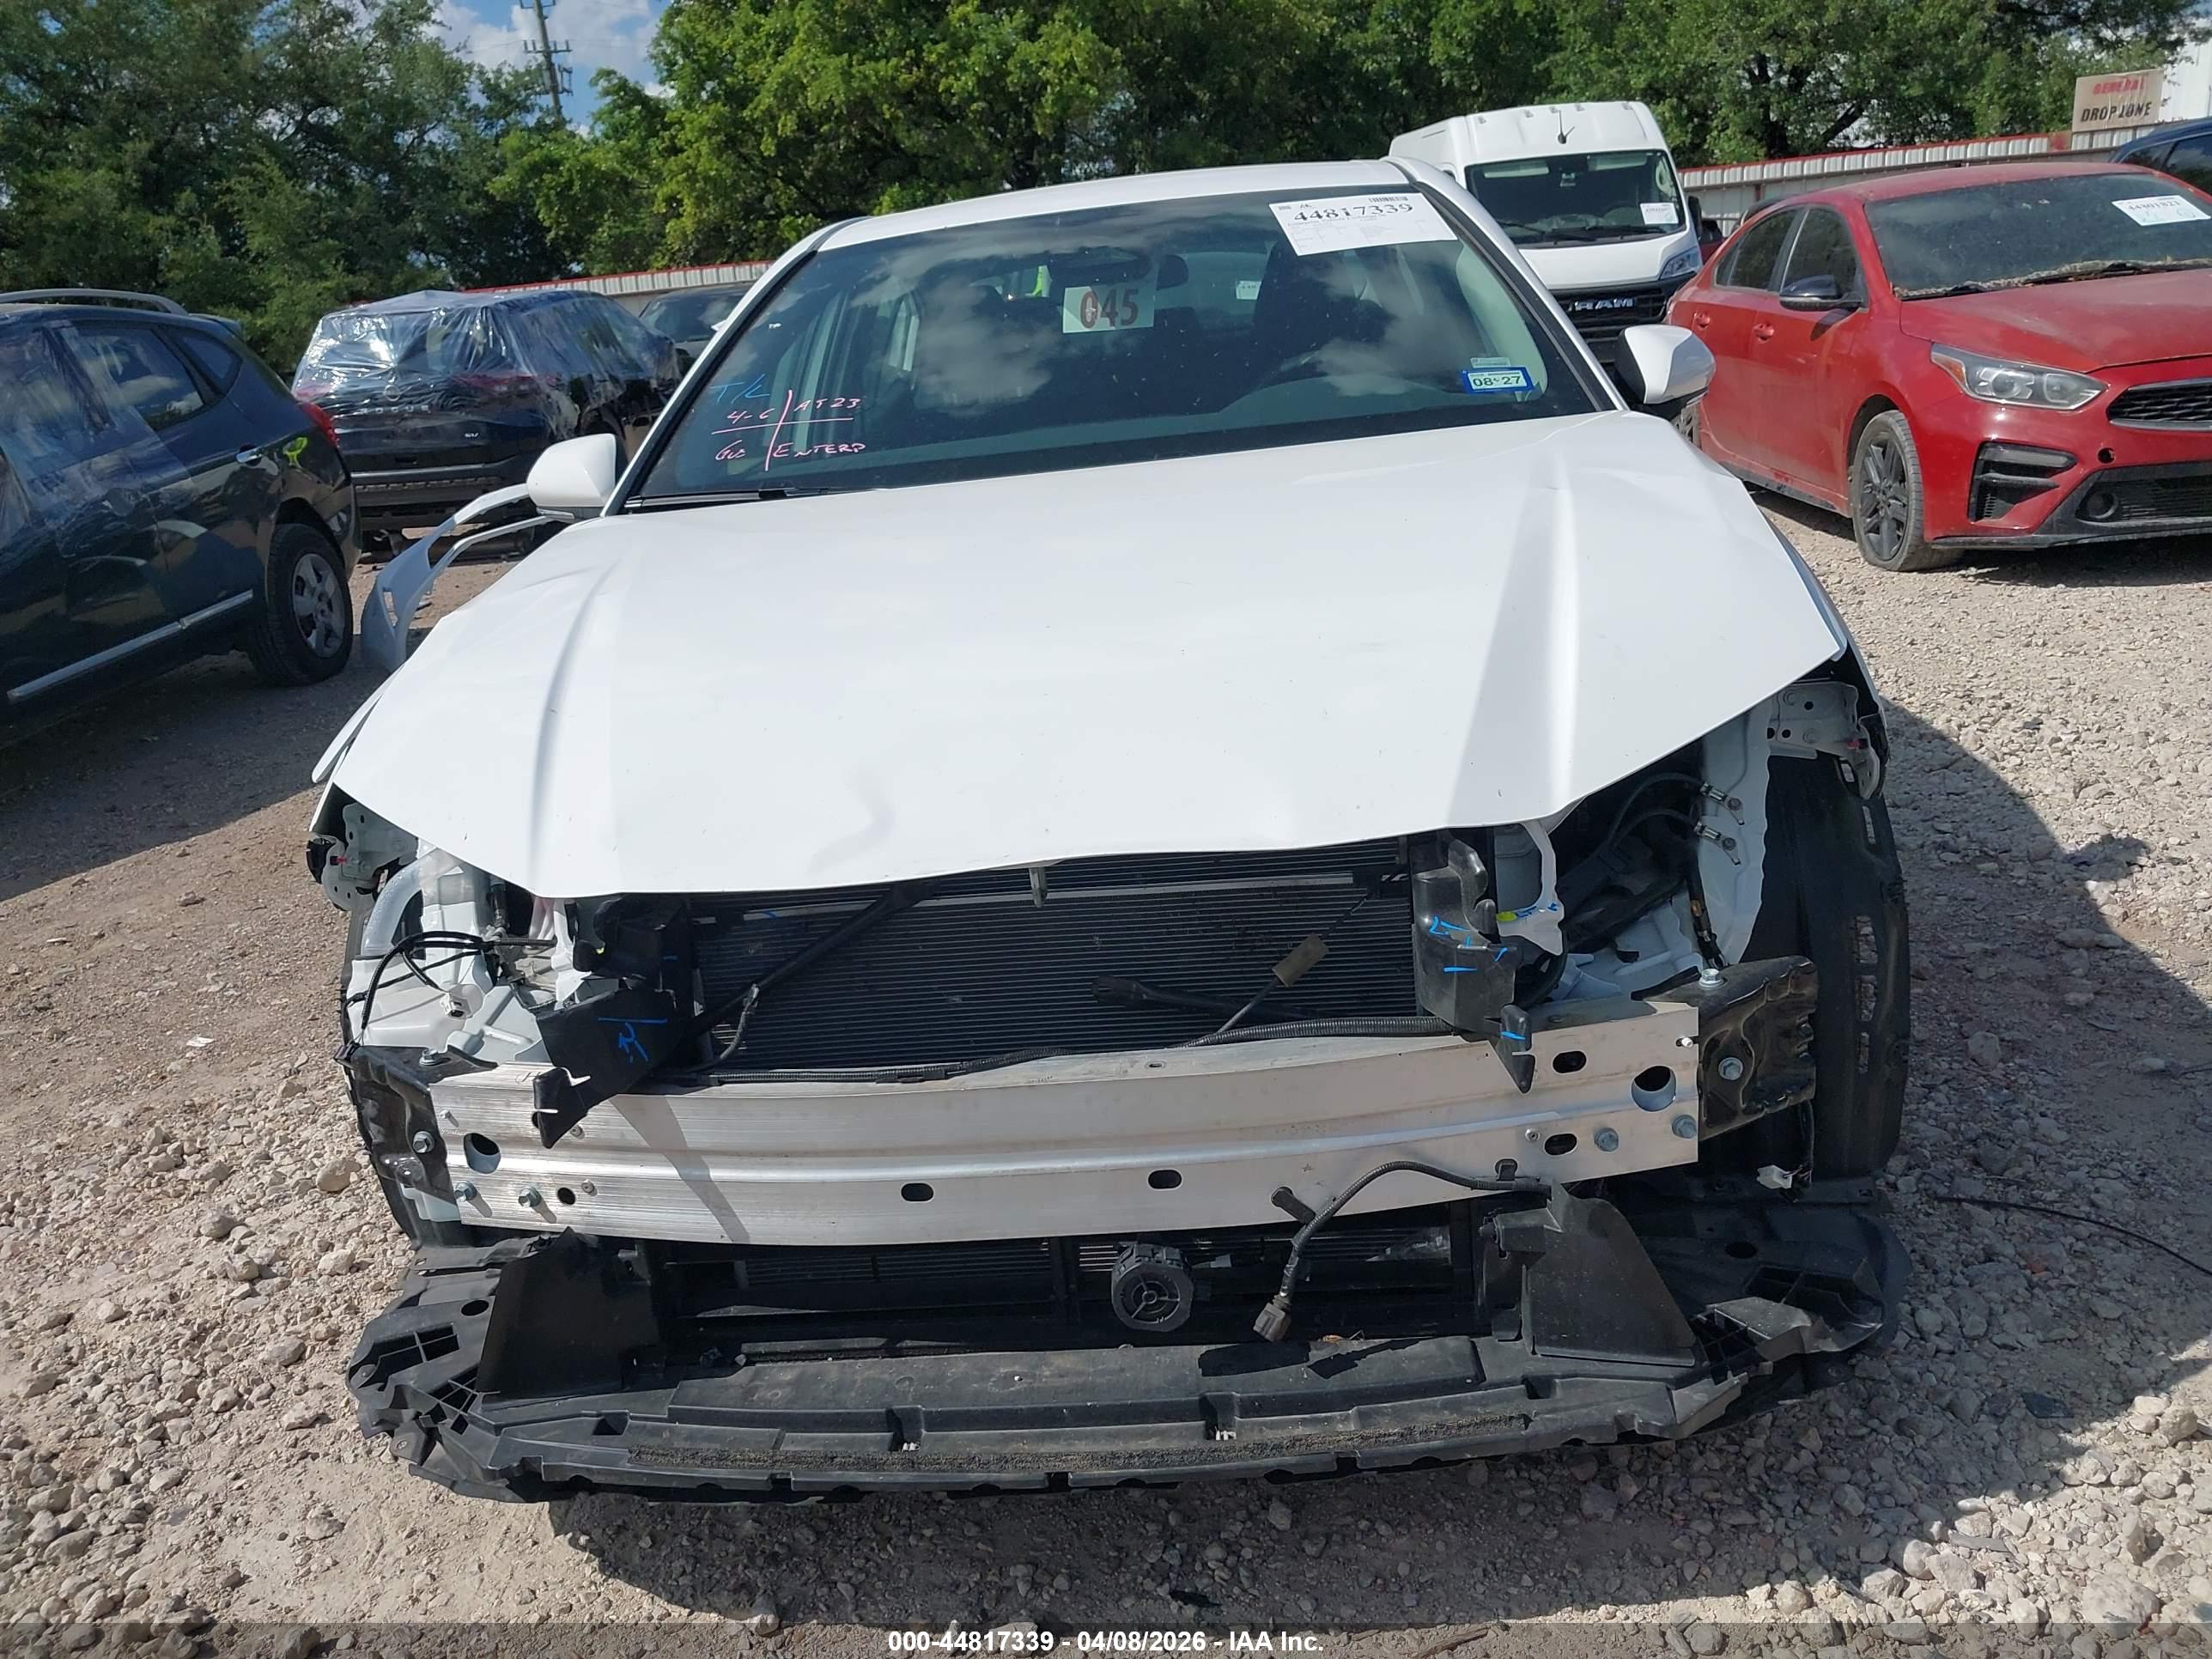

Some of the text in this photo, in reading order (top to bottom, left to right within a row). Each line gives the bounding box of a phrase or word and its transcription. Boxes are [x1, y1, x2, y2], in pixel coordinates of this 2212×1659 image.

[2081, 106, 2118, 122] DROP
[1294, 203, 1413, 222] 44817339
[1080, 289, 1139, 329] 045
[1574, 297, 1633, 311] RAM
